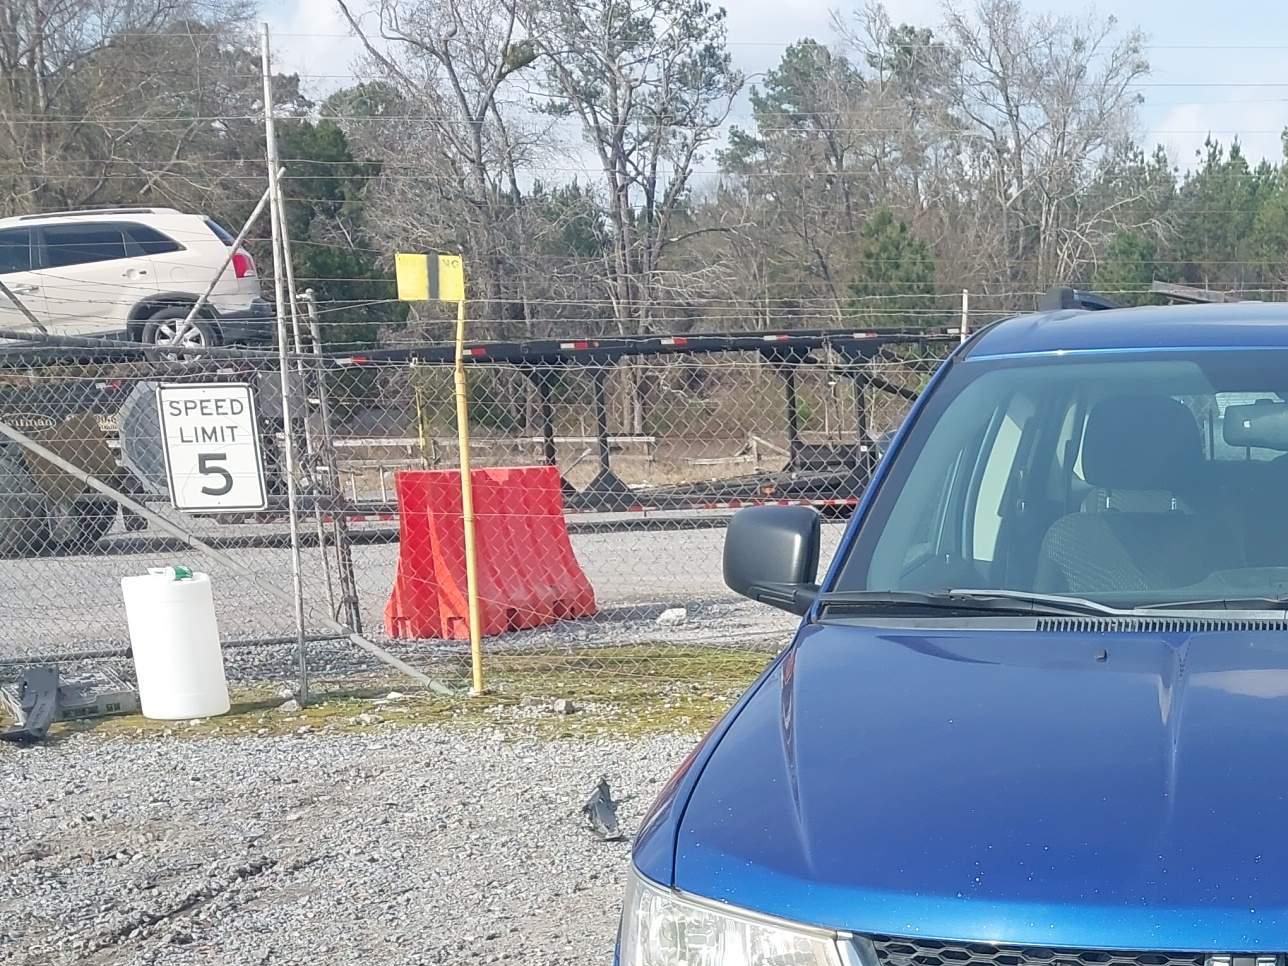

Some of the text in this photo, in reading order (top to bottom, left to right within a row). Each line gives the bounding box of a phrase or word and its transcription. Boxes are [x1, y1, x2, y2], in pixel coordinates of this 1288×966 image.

[169, 399, 244, 416] SPEED
[180, 426, 238, 443] LIMIT
[198, 453, 234, 496] 5
